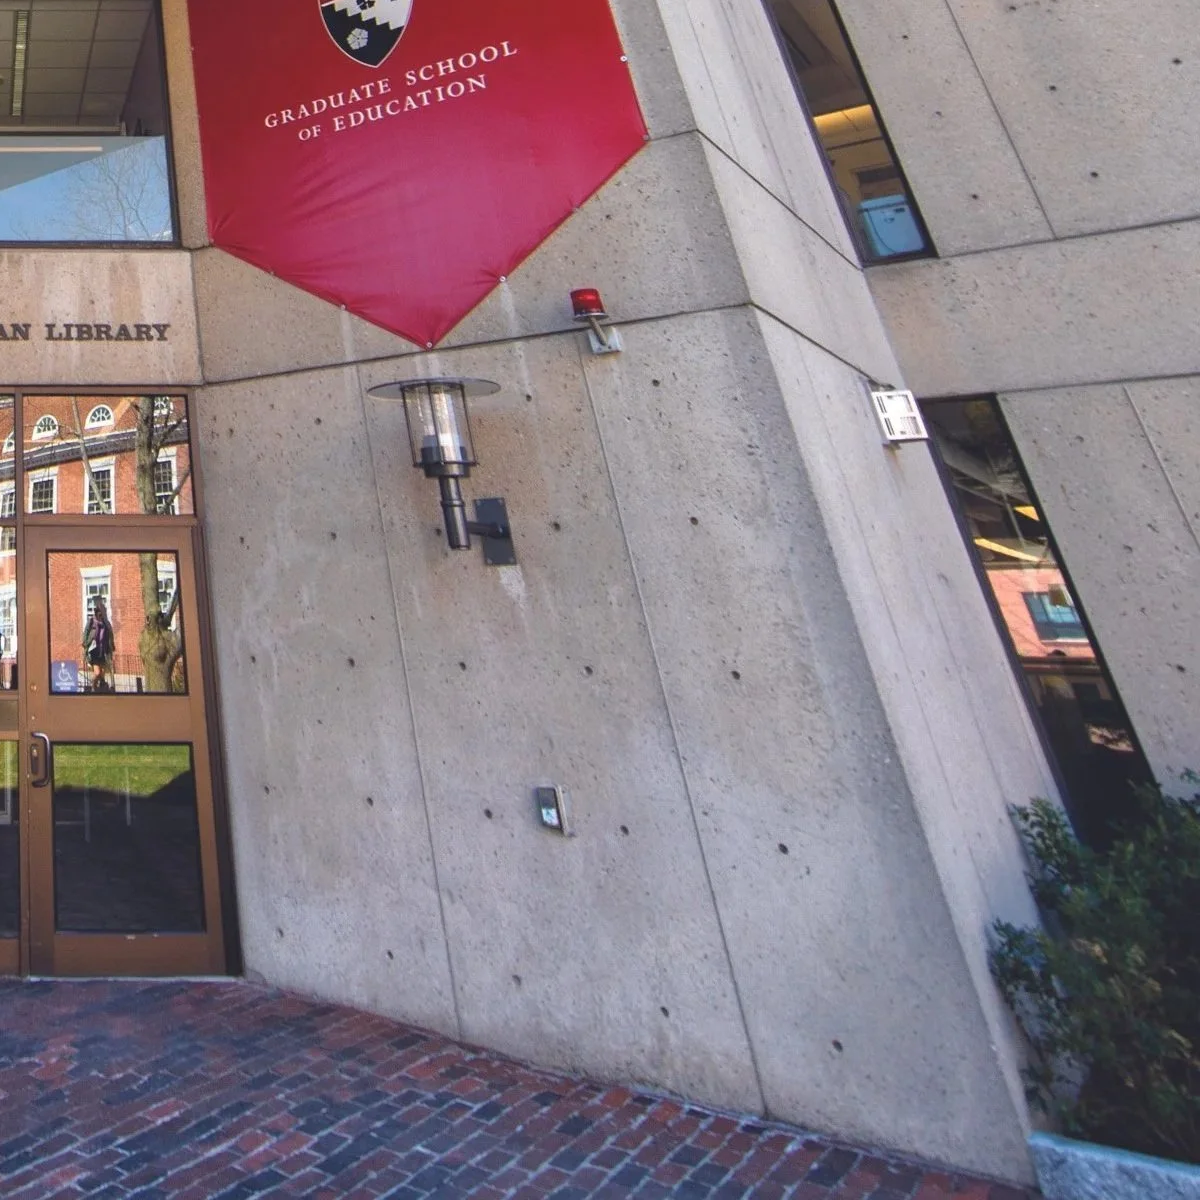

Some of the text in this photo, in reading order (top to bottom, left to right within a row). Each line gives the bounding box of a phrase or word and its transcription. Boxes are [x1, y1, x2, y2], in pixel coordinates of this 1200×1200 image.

[264, 40, 518, 128] GRADUATE SCHOOL
[298, 74, 488, 142] OF EDUCATION
[45, 322, 171, 341] LIBRARY
